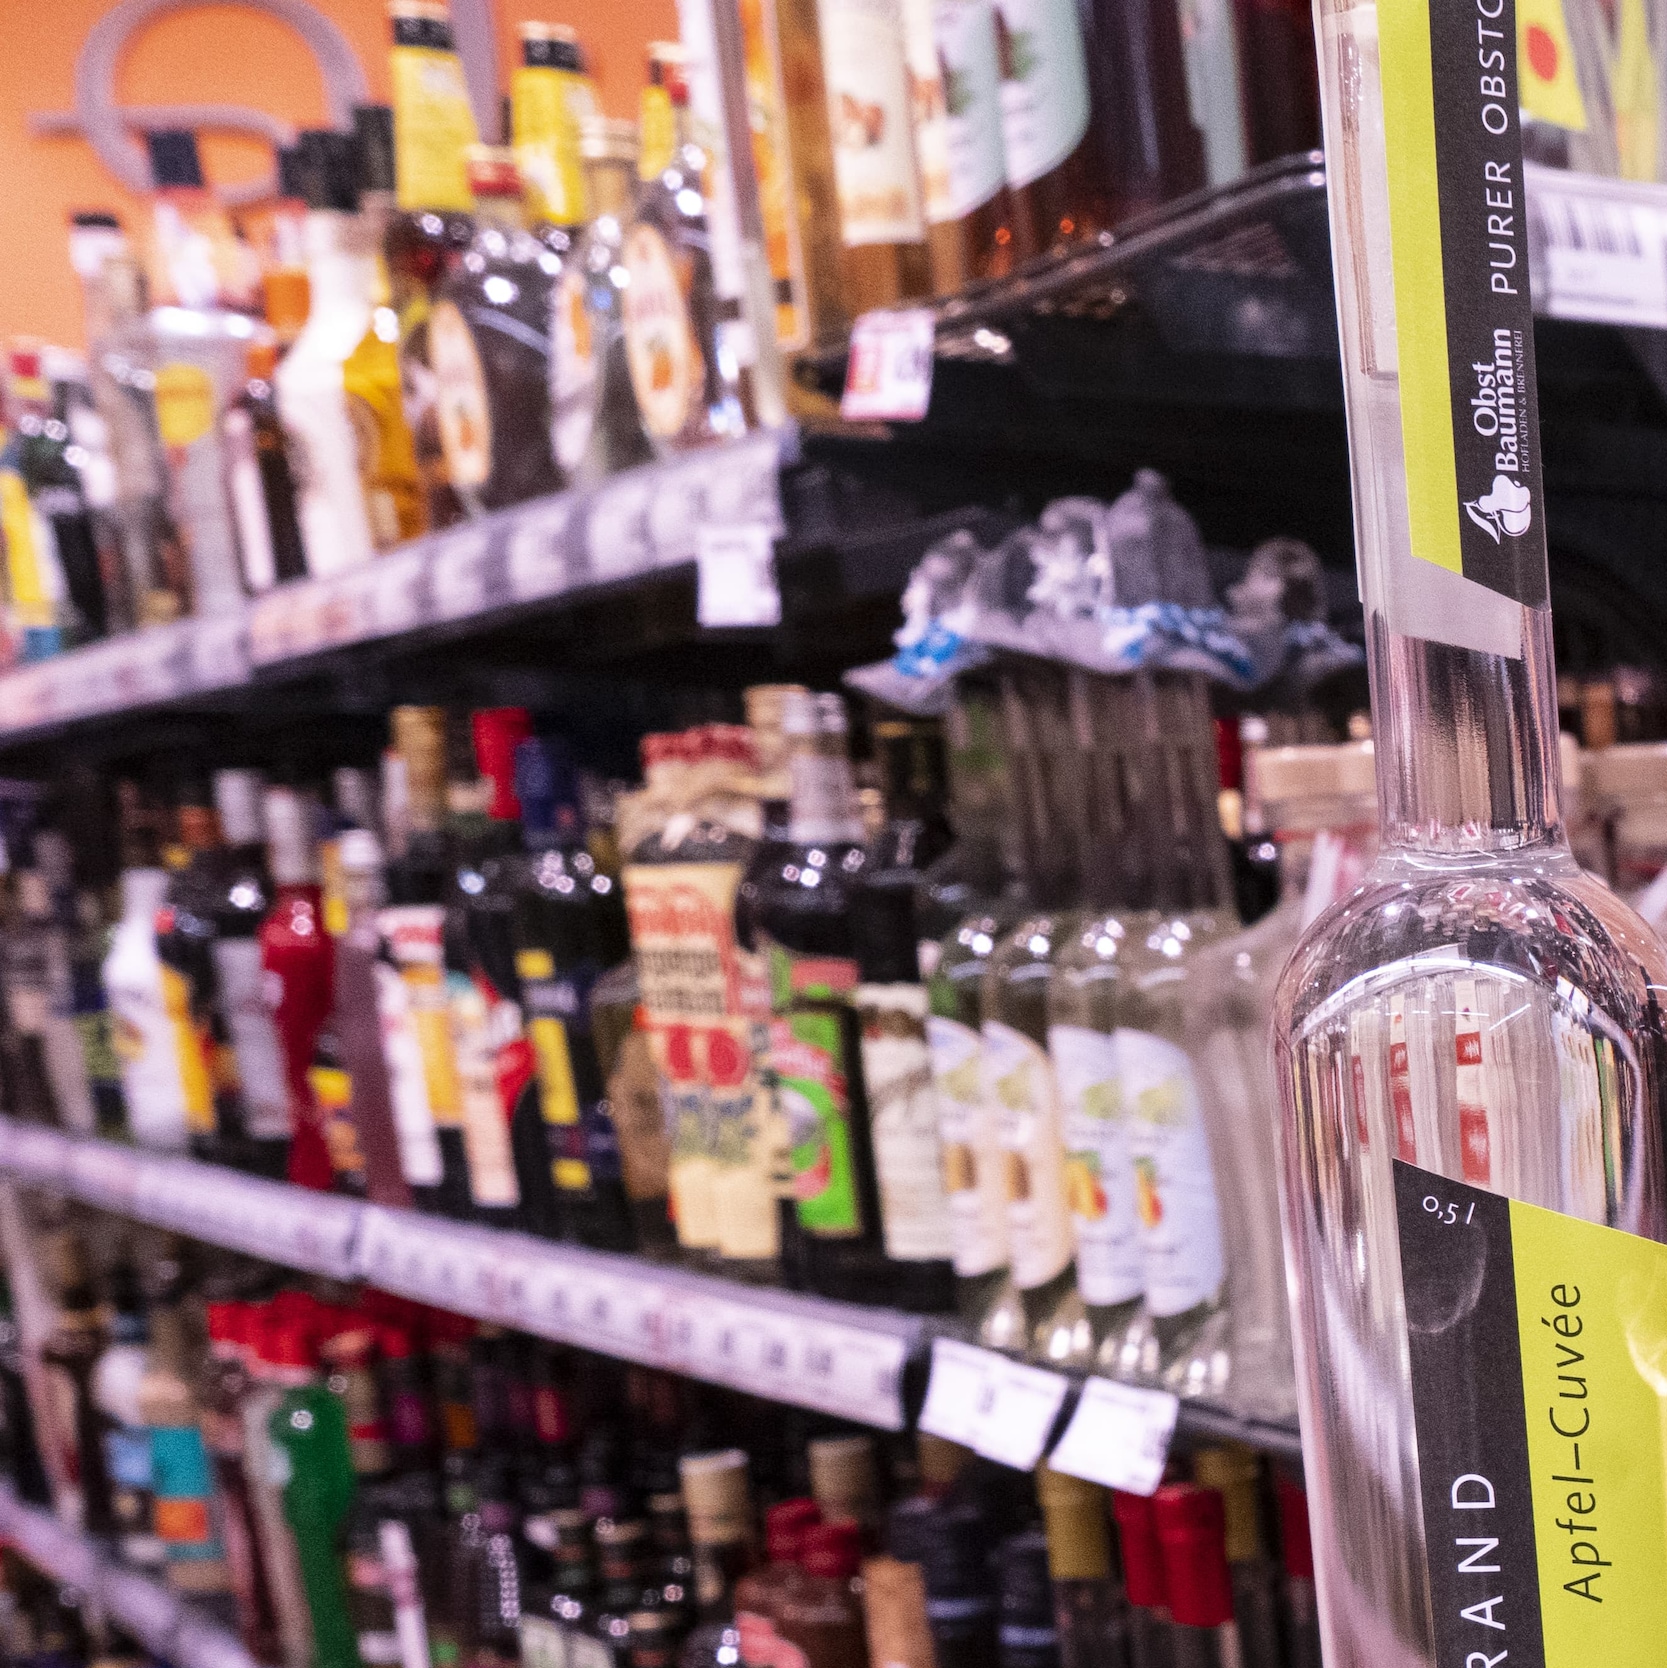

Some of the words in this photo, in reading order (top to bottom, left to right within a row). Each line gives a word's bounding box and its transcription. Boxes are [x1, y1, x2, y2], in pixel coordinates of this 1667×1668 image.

[1482, 160, 1518, 294] PURER
[1512, 329, 1527, 393] BRENNEREI
[1470, 360, 1499, 437] Obst
[1492, 328, 1520, 473] Baumann
[1516, 397, 1528, 406] &
[1516, 409, 1531, 473] HOFLADEN
[1422, 1195, 1460, 1226] 0,5
[1540, 1282, 1613, 1605] Apfel-Cuvée
